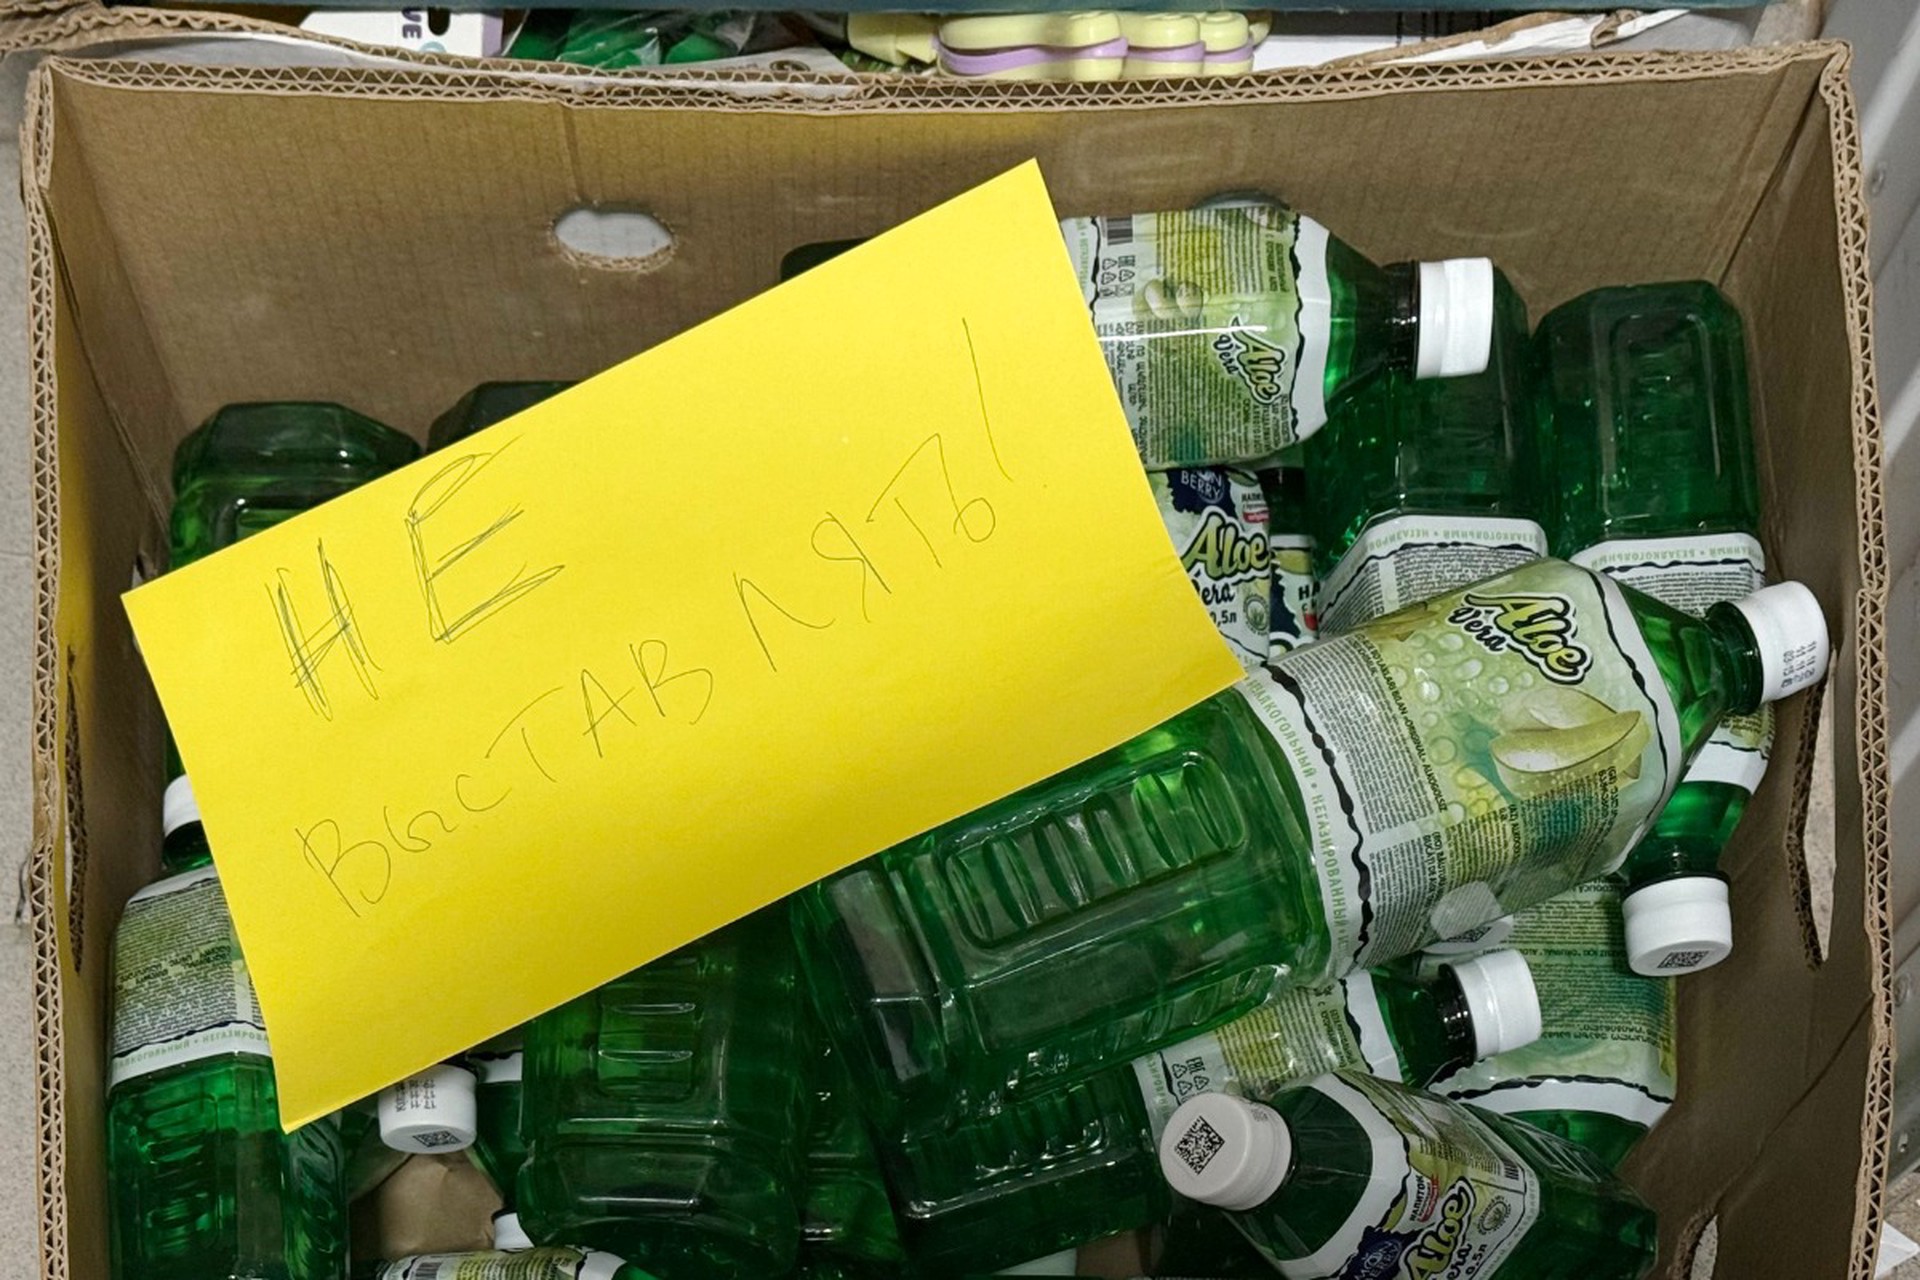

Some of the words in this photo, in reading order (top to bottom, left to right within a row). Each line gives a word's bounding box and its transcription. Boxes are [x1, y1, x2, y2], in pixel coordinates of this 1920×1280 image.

[1213, 332, 1240, 376] Vera
[1231, 317, 1285, 404] Aloe
[1180, 471, 1221, 500] BERRY
[1181, 510, 1270, 580] Aloe
[265, 434, 565, 722] НЕ
[1194, 580, 1237, 606] era
[1448, 603, 1508, 652] Vera
[1464, 592, 1590, 684] Aloe
[1312, 793, 1347, 929] НЕГАЗИРОВАННЫЙ
[118, 1039, 189, 1068] АЛКОГОЛЬНЫЙ
[1409, 1174, 1426, 1222] НАПИТОК
[1406, 1175, 1478, 1280] Aloe
[1446, 1242, 1472, 1280] era
